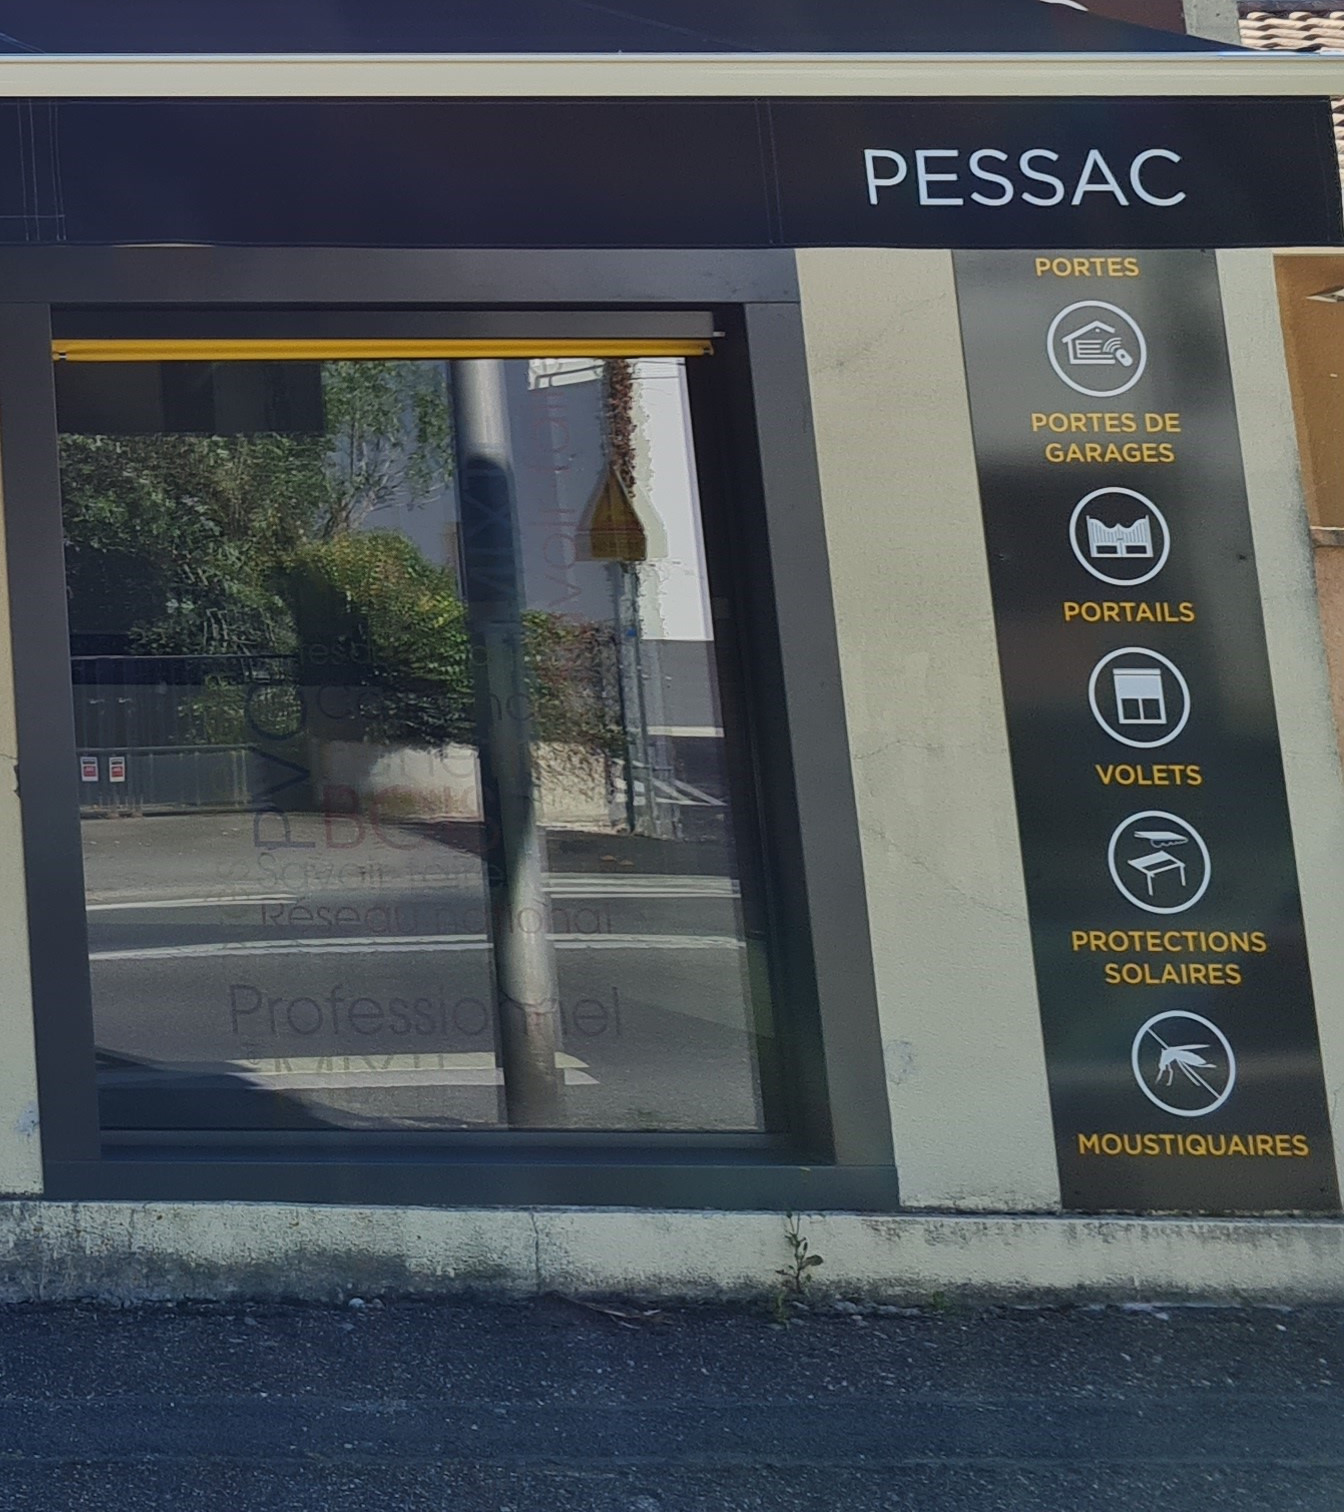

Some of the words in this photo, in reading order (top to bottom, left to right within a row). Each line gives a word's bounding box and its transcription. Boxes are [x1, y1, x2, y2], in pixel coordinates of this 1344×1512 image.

[864, 149, 1185, 206] PESSAC
[1036, 258, 1138, 276] PORTES
[1032, 413, 1136, 432] PORTES
[1145, 413, 1181, 432] DE
[1045, 443, 1175, 464] GARAGES
[1064, 602, 1194, 621] PORTAILS
[1096, 765, 1201, 785] VOLETS
[1072, 931, 1266, 951] PROTECTIONS
[1106, 964, 1241, 984] SOLAIRES
[1079, 1134, 1308, 1155] MOUSTIQUAIRES
